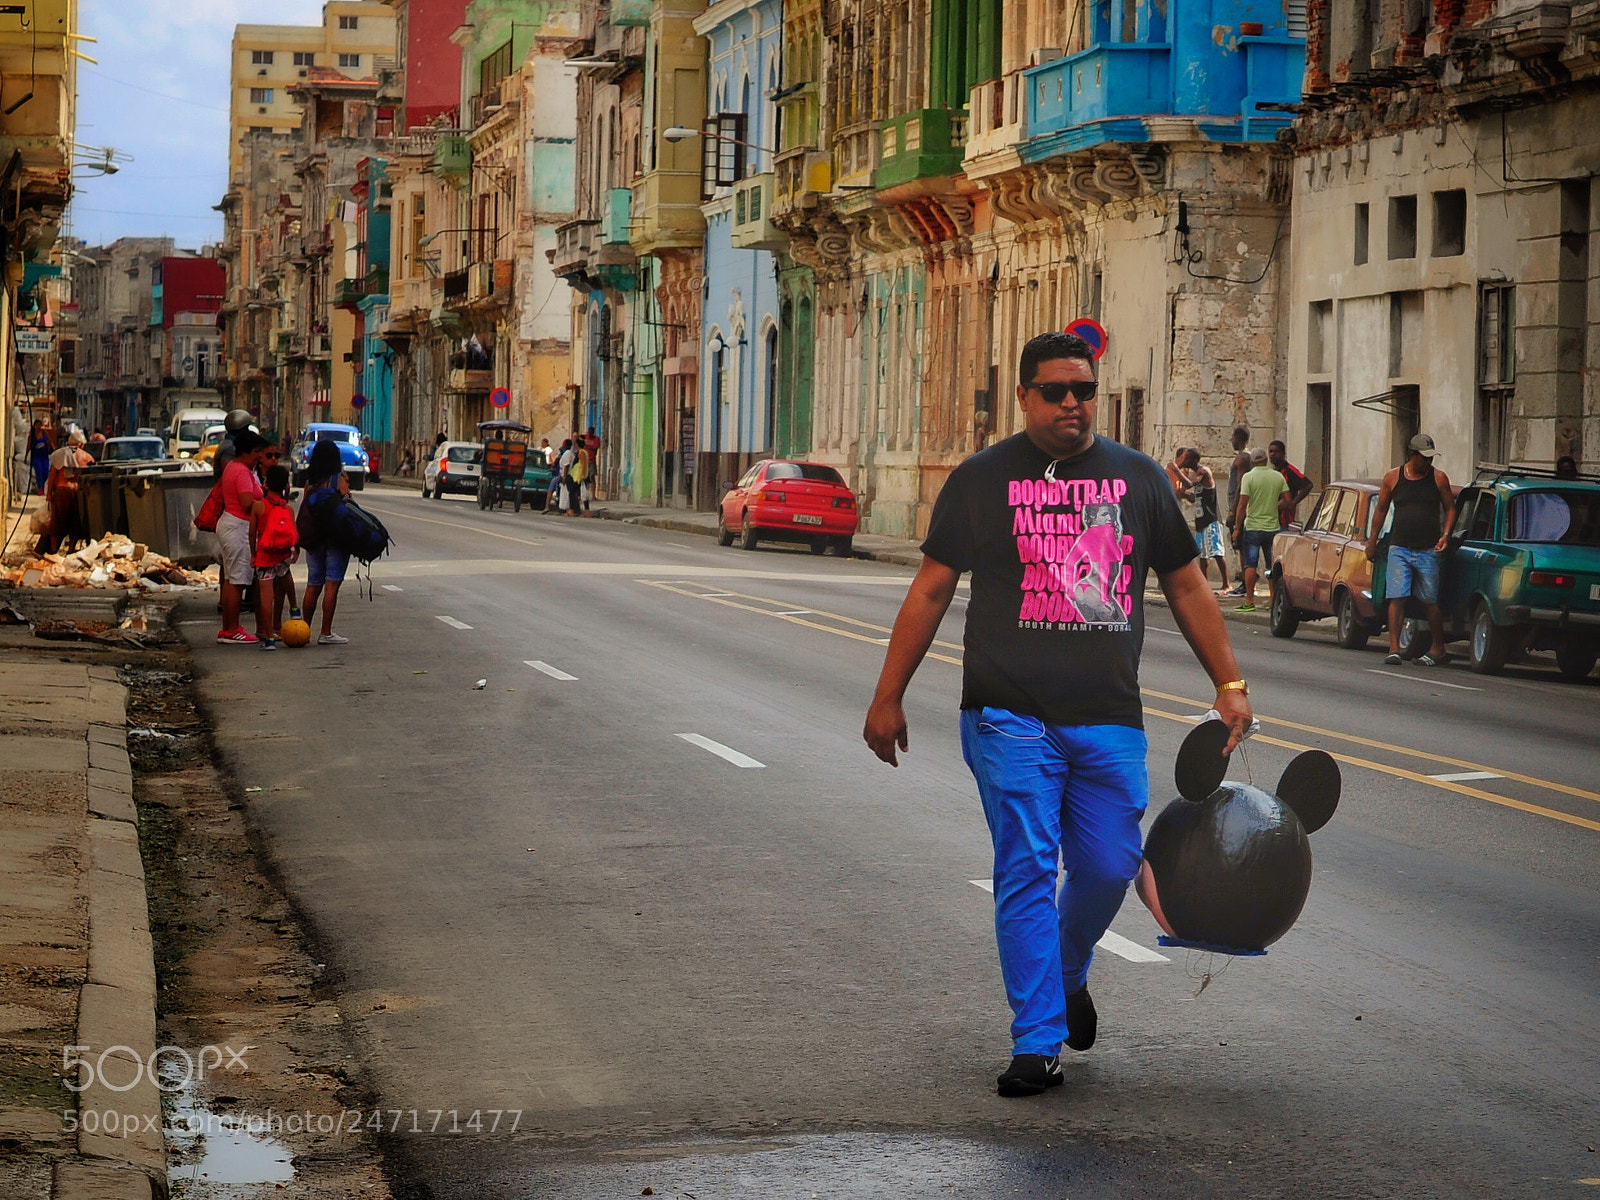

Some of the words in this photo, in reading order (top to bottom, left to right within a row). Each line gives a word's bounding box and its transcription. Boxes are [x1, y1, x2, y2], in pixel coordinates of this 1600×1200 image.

[1008, 479, 1128, 506] BOOBYTRAP
[1012, 503, 1082, 535] Miami
[1018, 620, 1052, 630] SOUTH
[1058, 623, 1092, 631] MIAMI
